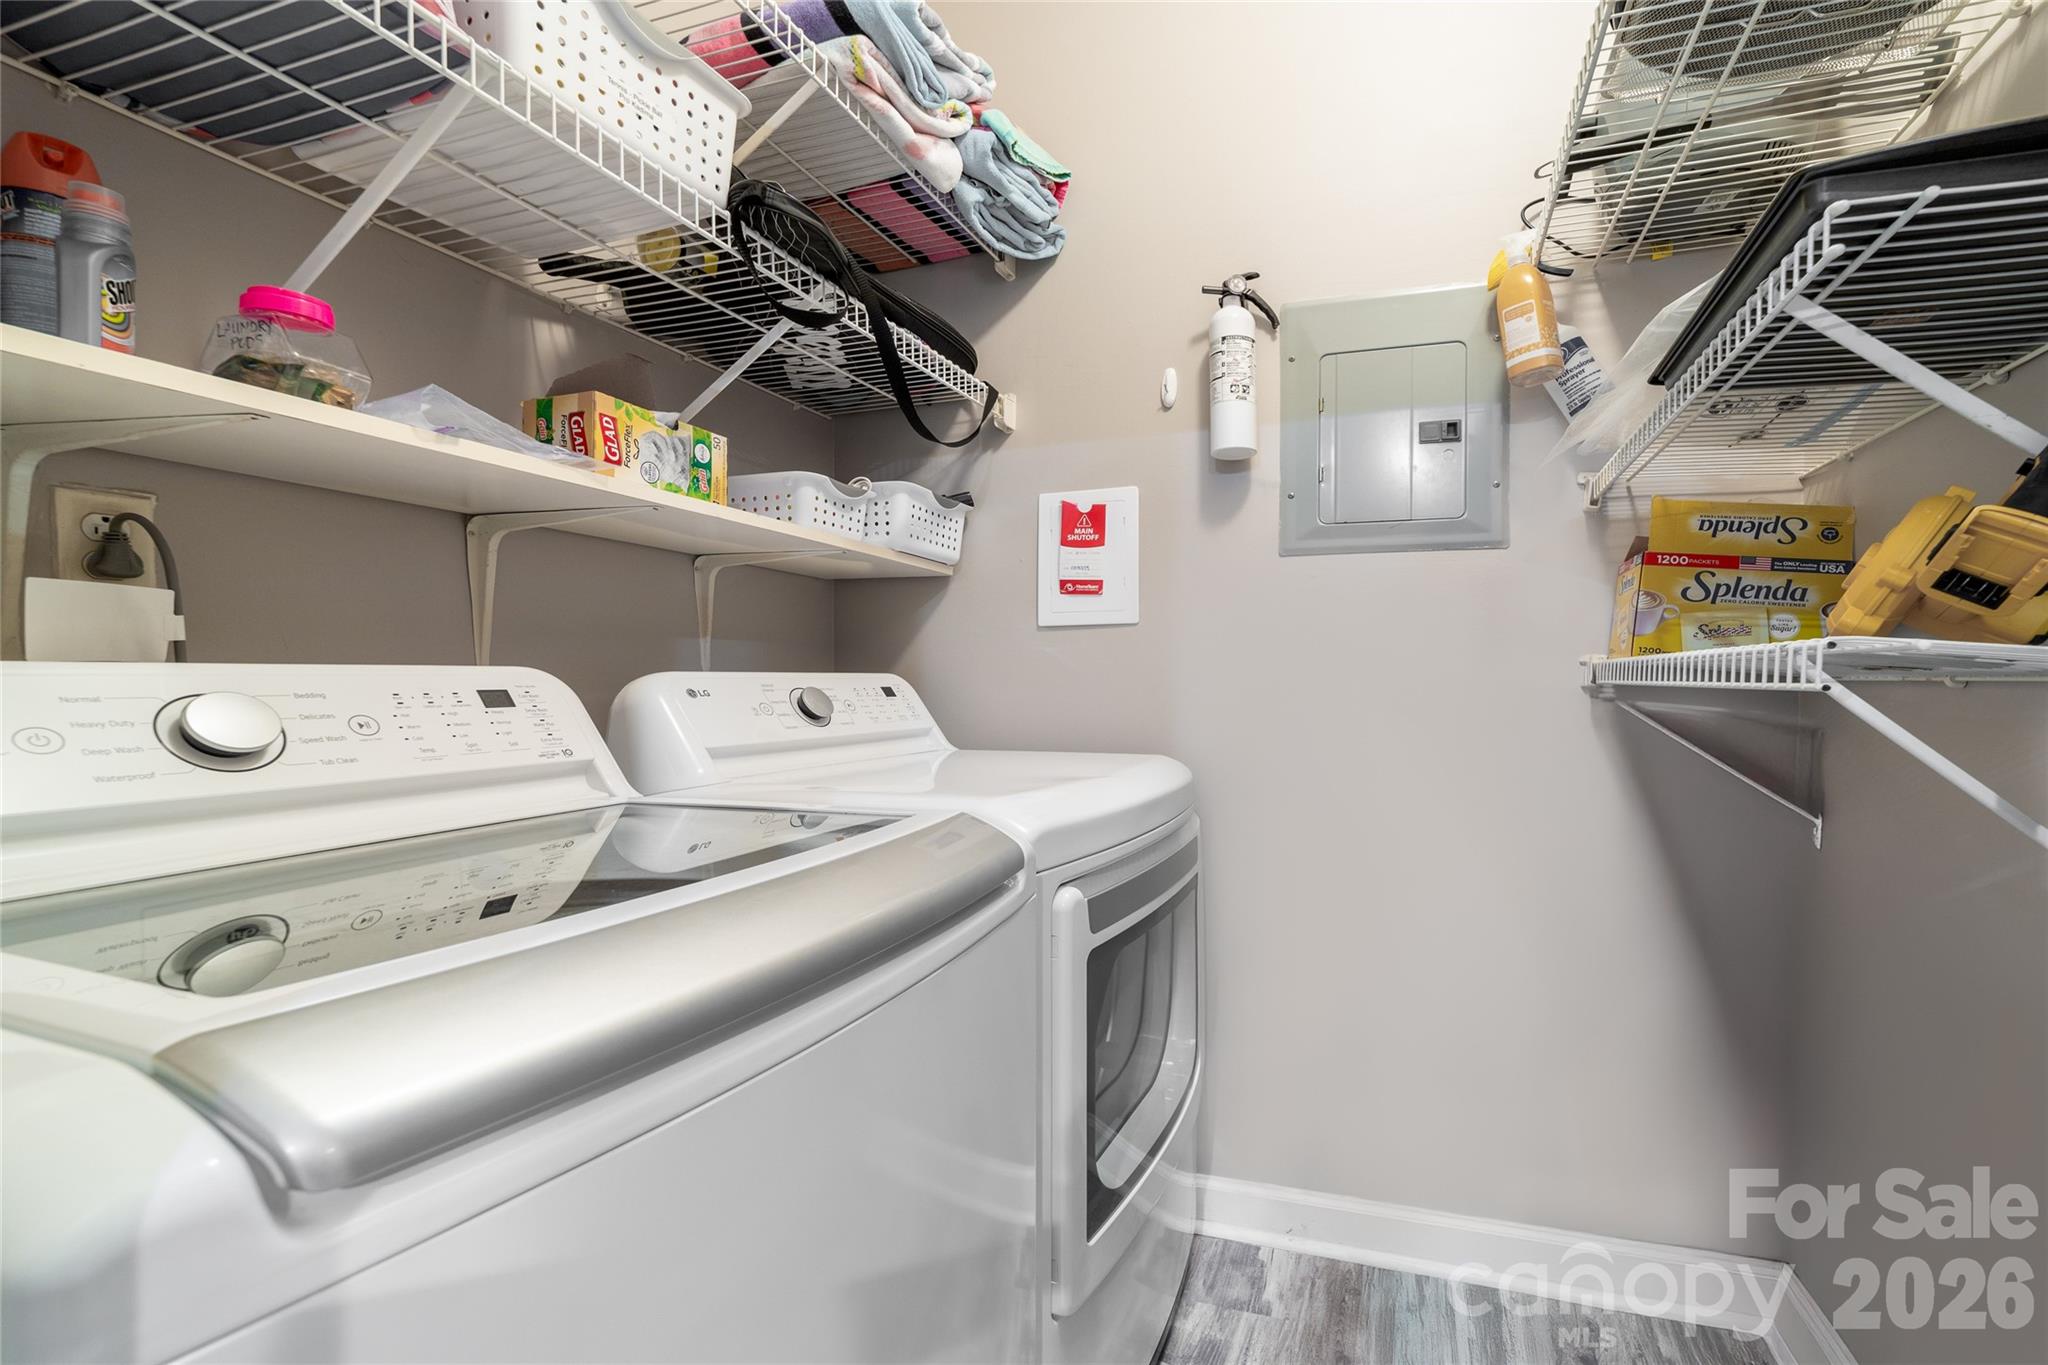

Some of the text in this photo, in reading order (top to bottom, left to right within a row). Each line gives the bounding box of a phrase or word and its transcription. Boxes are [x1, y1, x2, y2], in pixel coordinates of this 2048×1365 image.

[1558, 369, 1585, 387] Sprayer
[560, 414, 568, 448] ForceFl
[602, 416, 620, 461] GLAD
[713, 437, 721, 450] 50
[623, 424, 632, 468] ForceFlex
[1698, 516, 1808, 545] Splenda
[1656, 555, 1688, 565] 1200
[1820, 564, 1845, 574] USA
[1681, 571, 1808, 604] Splenda
[1639, 646, 1662, 654] 1200
[70, 721, 105, 729] Heavy
[81, 747, 113, 756] Deep
[92, 771, 156, 783] Waterproof
